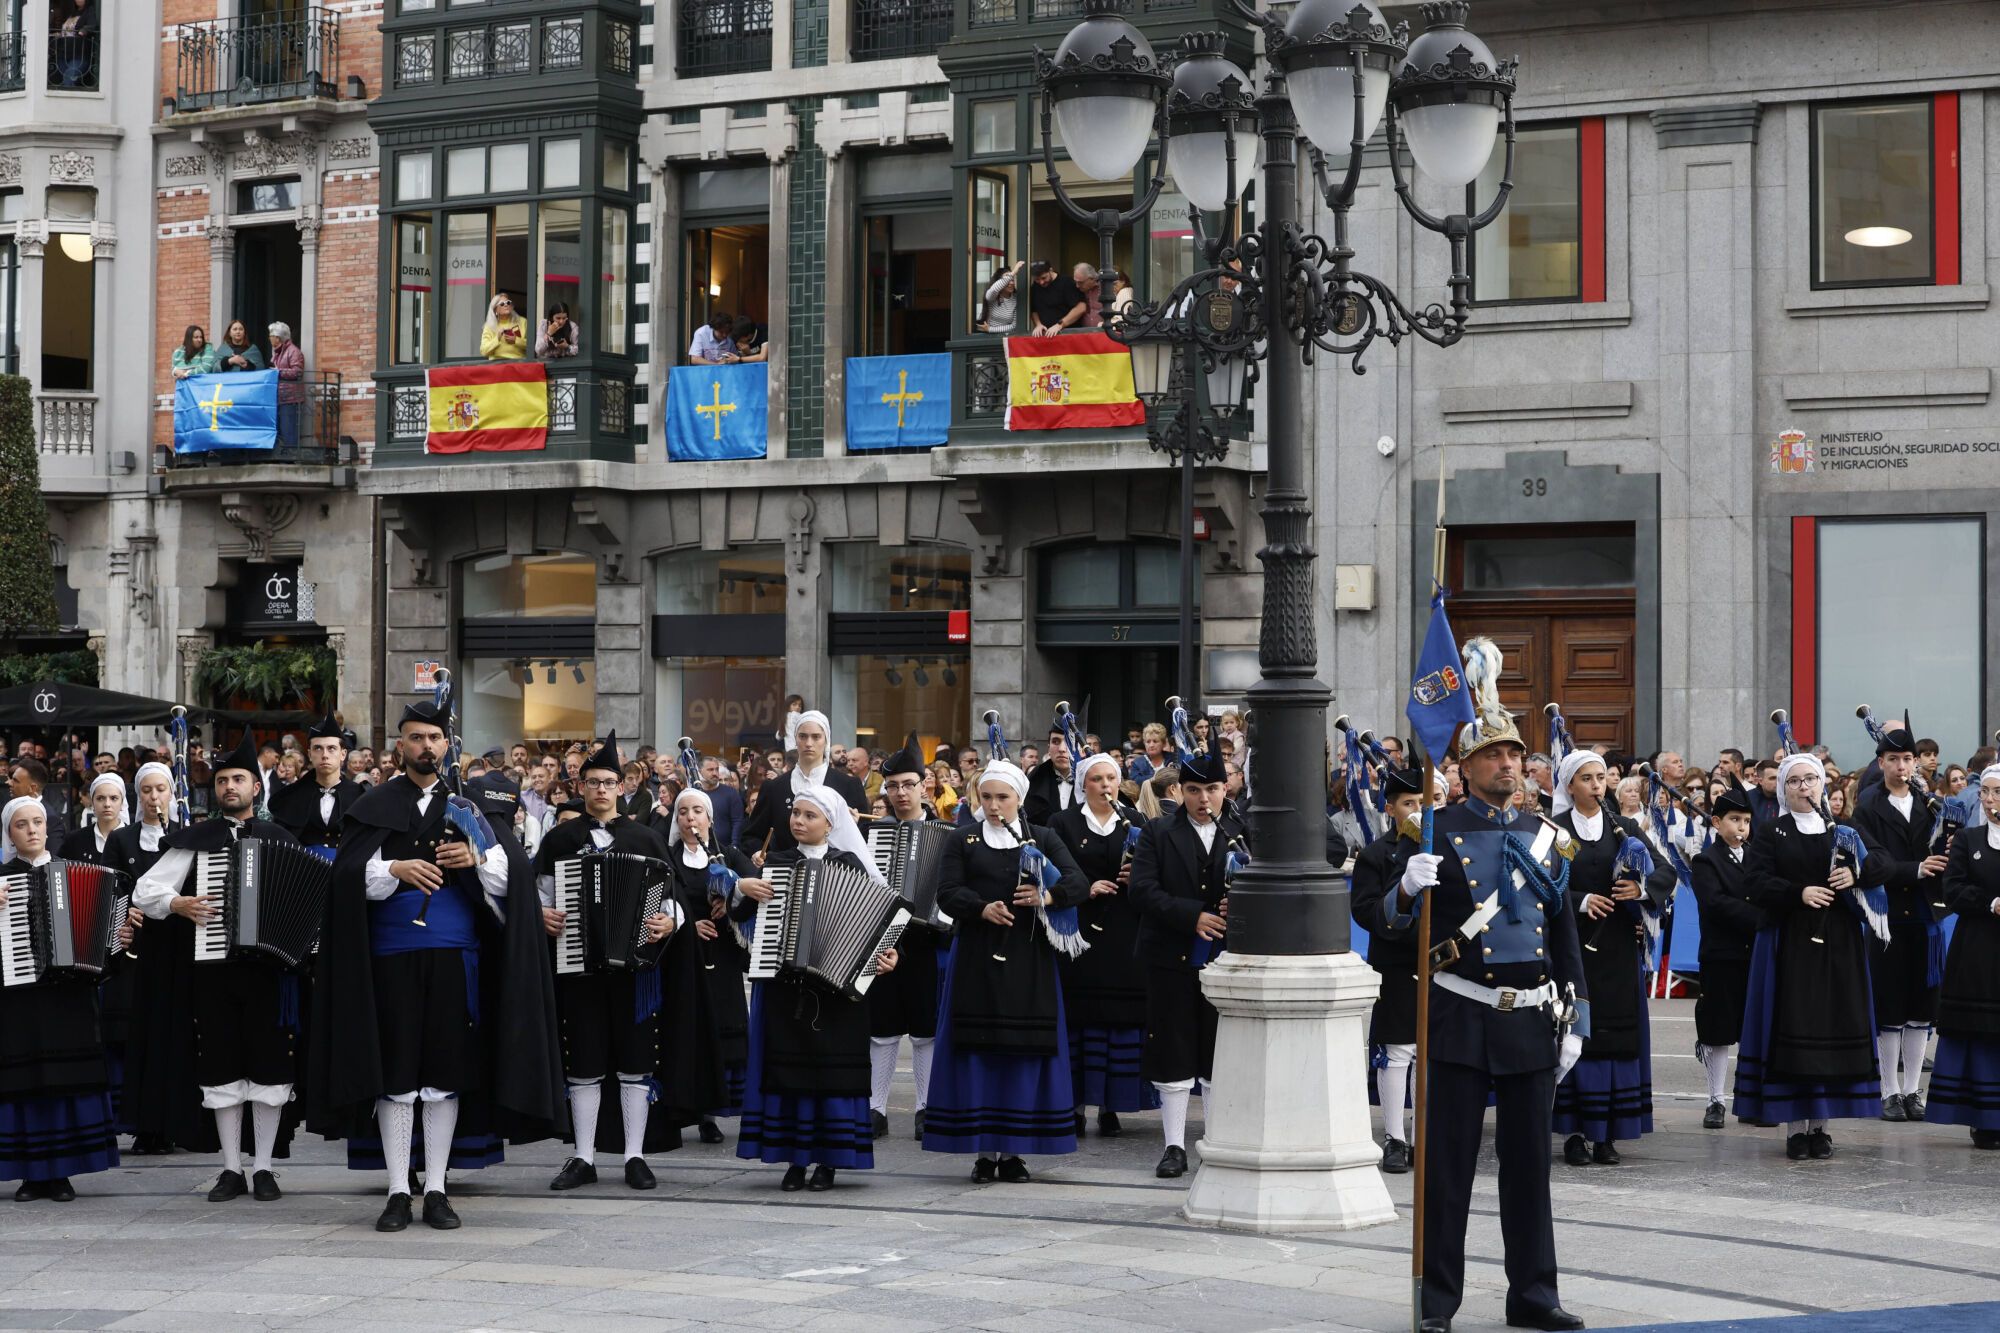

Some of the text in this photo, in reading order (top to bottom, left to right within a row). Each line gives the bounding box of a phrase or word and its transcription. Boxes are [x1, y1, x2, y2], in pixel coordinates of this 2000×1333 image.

[452, 257, 483, 269] ÓPERA
[1820, 431, 1883, 443] MINISTERIO
[1820, 442, 2000, 457] DE INCLUSIÓN, SEGURIDAD SOCI
[1820, 458, 1909, 470] Y MIGRACIONES
[1522, 477, 1547, 497] 39
[1111, 625, 1130, 641] 37
[910, 830, 919, 861] HOHNER
[246, 848, 254, 888] HOHNER
[54, 871, 64, 910] HOHNER
[806, 870, 817, 904] HOHNER
